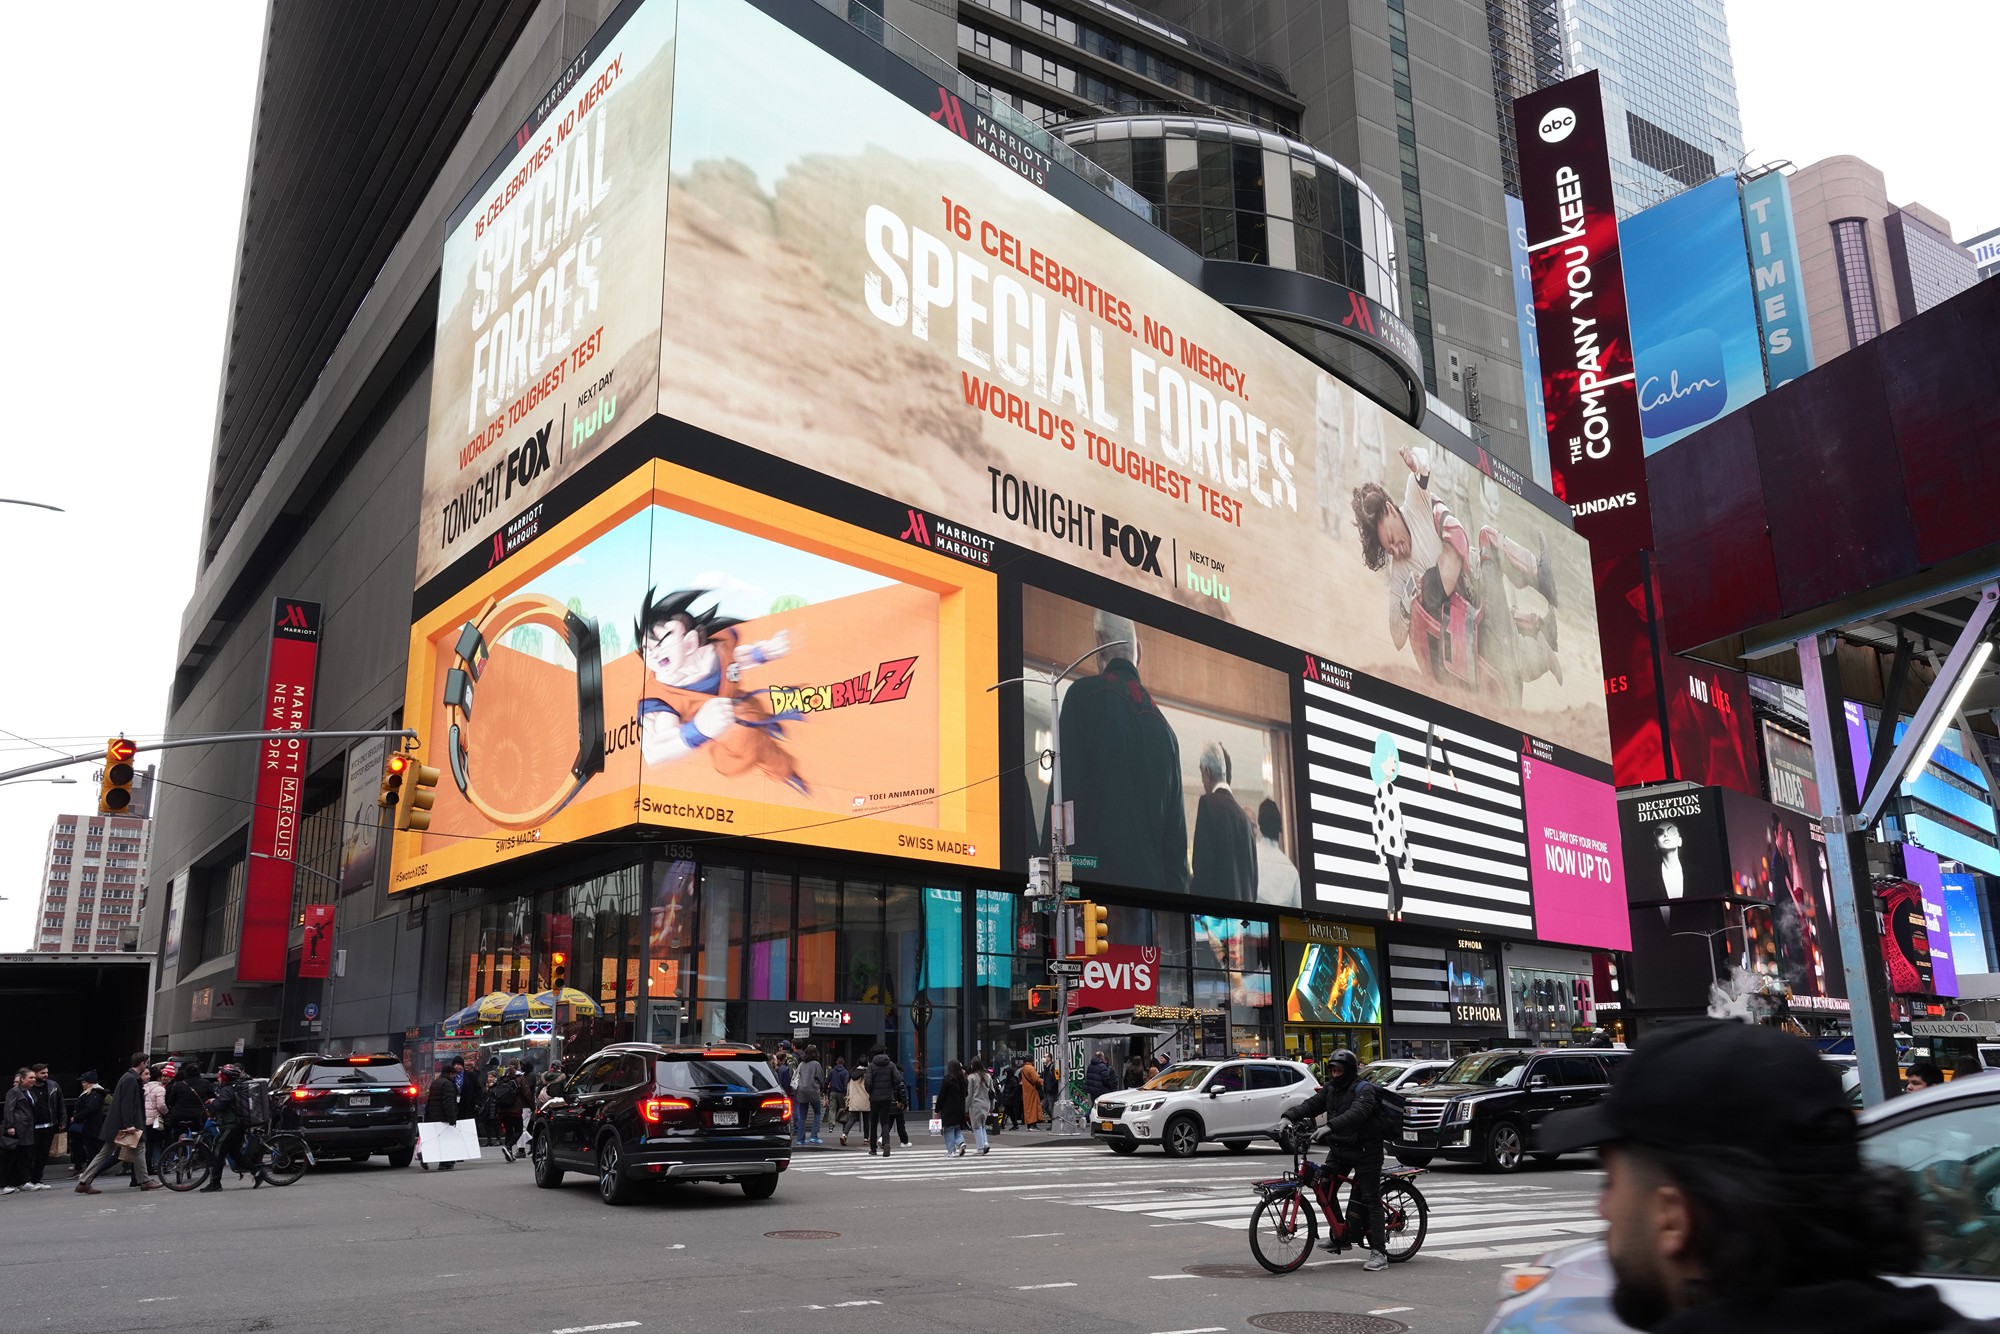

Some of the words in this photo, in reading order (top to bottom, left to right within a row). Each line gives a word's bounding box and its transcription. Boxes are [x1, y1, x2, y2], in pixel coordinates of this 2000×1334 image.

[537, 50, 587, 121] MARRIOTT
[1541, 115, 1574, 134] abc
[474, 218, 485, 242] 16
[487, 136, 554, 227] CELEBRITIES.
[557, 109, 575, 147] NO
[577, 52, 624, 123] MERCY.
[976, 114, 1052, 173] MARRIOTT
[976, 131, 1045, 186] MARQUIS
[471, 101, 612, 331] SPECIAL
[1556, 165, 1586, 239] KEEP
[1564, 244, 1594, 312] YOU
[1750, 197, 1793, 355] TIMES
[941, 195, 973, 242] 16
[980, 220, 1138, 338] CELEBRITIES.
[1143, 315, 1174, 357] NO
[1179, 336, 1250, 402] MERCY.
[468, 221, 602, 435] FORCES
[864, 204, 1119, 434] SPECIAL
[1130, 352, 1298, 513] FORCES
[458, 414, 505, 472] WORLD'S
[508, 357, 567, 430] TOUGHEST
[571, 326, 604, 375] TEST
[577, 383, 598, 409] NEXT
[598, 368, 615, 392] DAY
[1573, 315, 1612, 460] COMPANY
[1638, 369, 1720, 412] Calm
[571, 394, 617, 450] hulu
[961, 371, 1076, 452] WORLD'S
[1083, 428, 1192, 505] TOUGHEST
[1197, 483, 1243, 528] TEST
[1569, 435, 1583, 465] THE
[441, 460, 504, 550] TONIGHT
[505, 419, 553, 501] FOX
[1492, 458, 1524, 485] MARRIOTT
[1493, 470, 1522, 496] MARQUIS
[508, 503, 543, 537] MARRIOTT
[1570, 491, 1637, 518] SUNDAYS
[506, 522, 539, 551] MARQUIS
[936, 521, 996, 553] MARRIOTT
[987, 465, 1096, 551] TONIGHT
[1101, 514, 1163, 578] FOX
[936, 535, 990, 566] MARQUIS
[1188, 549, 1209, 571] NEXT
[1210, 556, 1226, 574] DAY
[1186, 564, 1231, 603] hulu
[283, 626, 317, 636] MARRIOTT
[1320, 661, 1353, 680] MARRIOTT
[1321, 672, 1351, 690] MARQUIS
[273, 683, 287, 719] NEW
[1689, 675, 1709, 704] AND
[1710, 685, 1731, 714] LIES
[285, 685, 305, 772] MARROTT
[1532, 739, 1554, 753] MARRIOTT
[1533, 748, 1553, 761] MARQUIS
[869, 792, 887, 801] TOEI
[888, 787, 935, 799] ANIMATION
[1637, 794, 1700, 813] DECEPTION
[276, 779, 296, 857] MARQUIS
[633, 796, 734, 824] #SwatchXDBZ
[1638, 804, 1702, 823] DIAMONDS
[495, 835, 516, 853] SWISS
[516, 830, 536, 847] MADE
[663, 843, 694, 859] 1535
[898, 834, 934, 851] SWISS
[937, 840, 968, 855] MADE
[1543, 827, 1560, 842] WE'LL
[1559, 831, 1569, 844] PAY
[1569, 834, 1579, 846] OFF
[1579, 836, 1592, 849] YOUR
[1591, 840, 1608, 854] PHONE
[395, 864, 429, 882] #SwatchXDBZ
[1070, 856, 1097, 869] Broadway
[1545, 844, 1576, 876] NOW
[1578, 853, 1594, 880] UP
[1594, 855, 1612, 884] TO
[1308, 922, 1350, 942] INVICTA
[1458, 939, 1483, 950] SEPHORA
[1067, 964, 1080, 972] WAY
[1456, 1004, 1502, 1022] SEPHORA
[1913, 1023, 1979, 1034] SWAROVSKI
